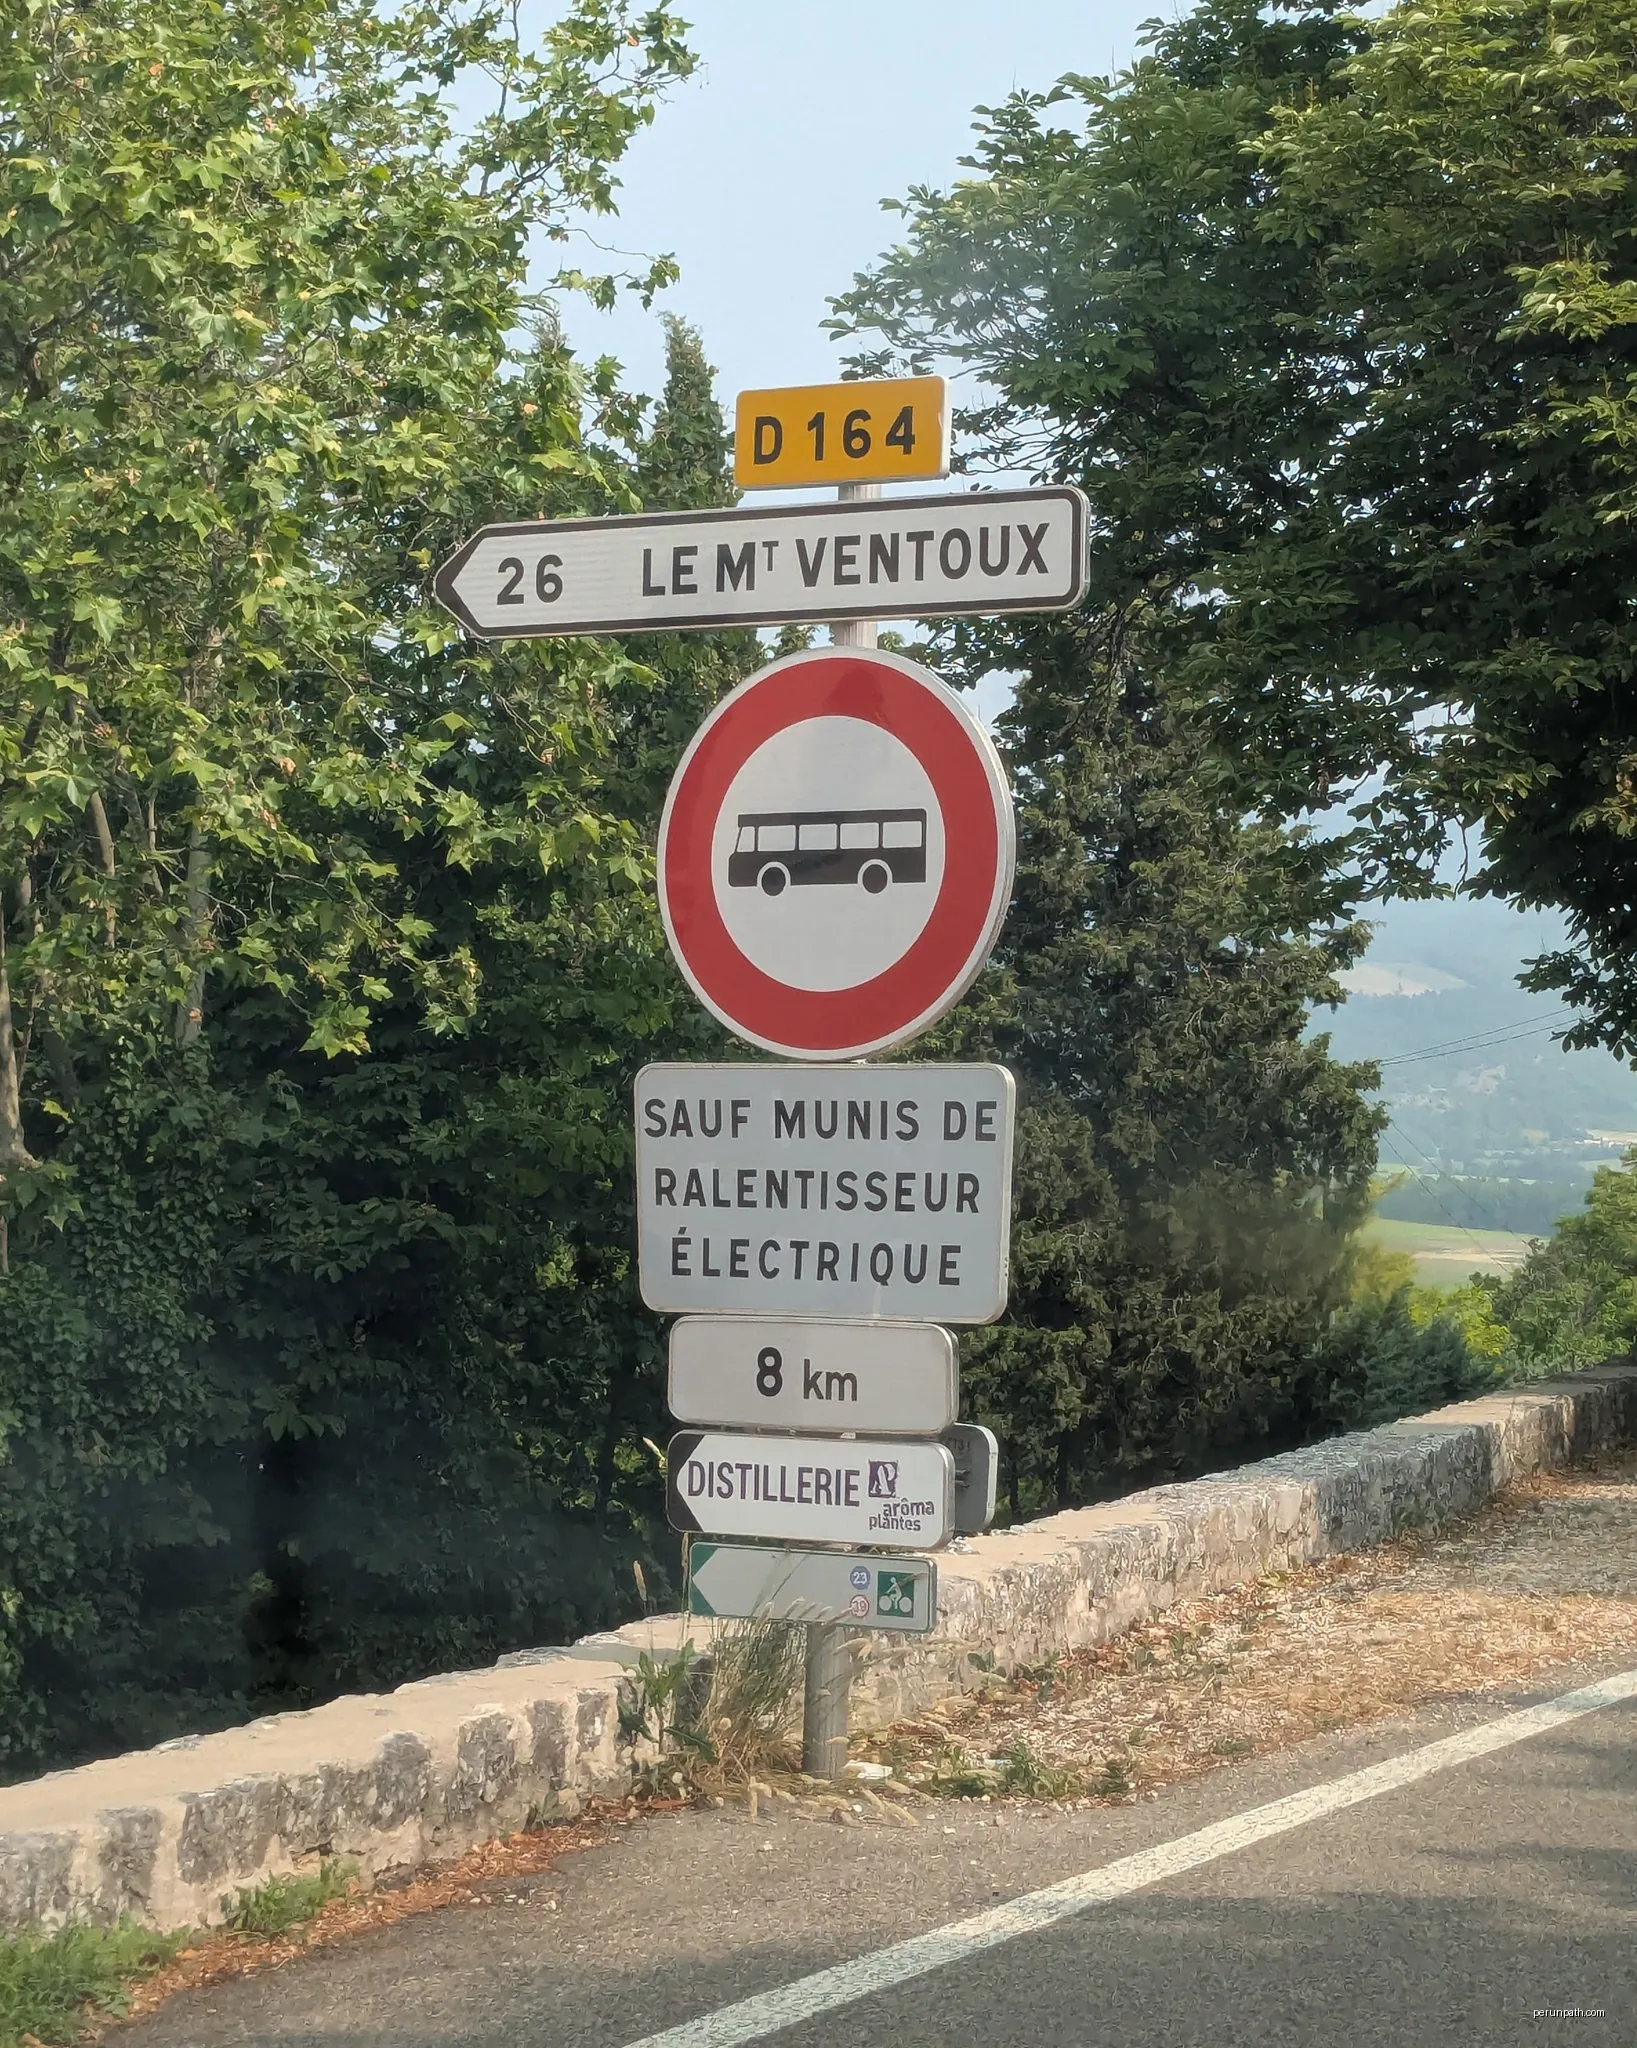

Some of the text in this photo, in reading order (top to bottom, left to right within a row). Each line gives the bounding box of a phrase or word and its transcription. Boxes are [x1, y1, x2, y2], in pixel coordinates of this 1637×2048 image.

[753, 405, 916, 464] D 164
[497, 554, 564, 605] 26
[642, 545, 699, 597] LE
[795, 522, 1050, 588] VENTOUX
[644, 1099, 997, 1141] SAUF MUNIS DE
[655, 1168, 980, 1213] RALENTISSEUR
[671, 1227, 961, 1286] ÉLECTRIQUE
[756, 1347, 858, 1401] 8 km
[687, 1461, 860, 1506] DISTILLERIE
[869, 1513, 921, 1531] plantes
[883, 1497, 934, 1516] arôma
